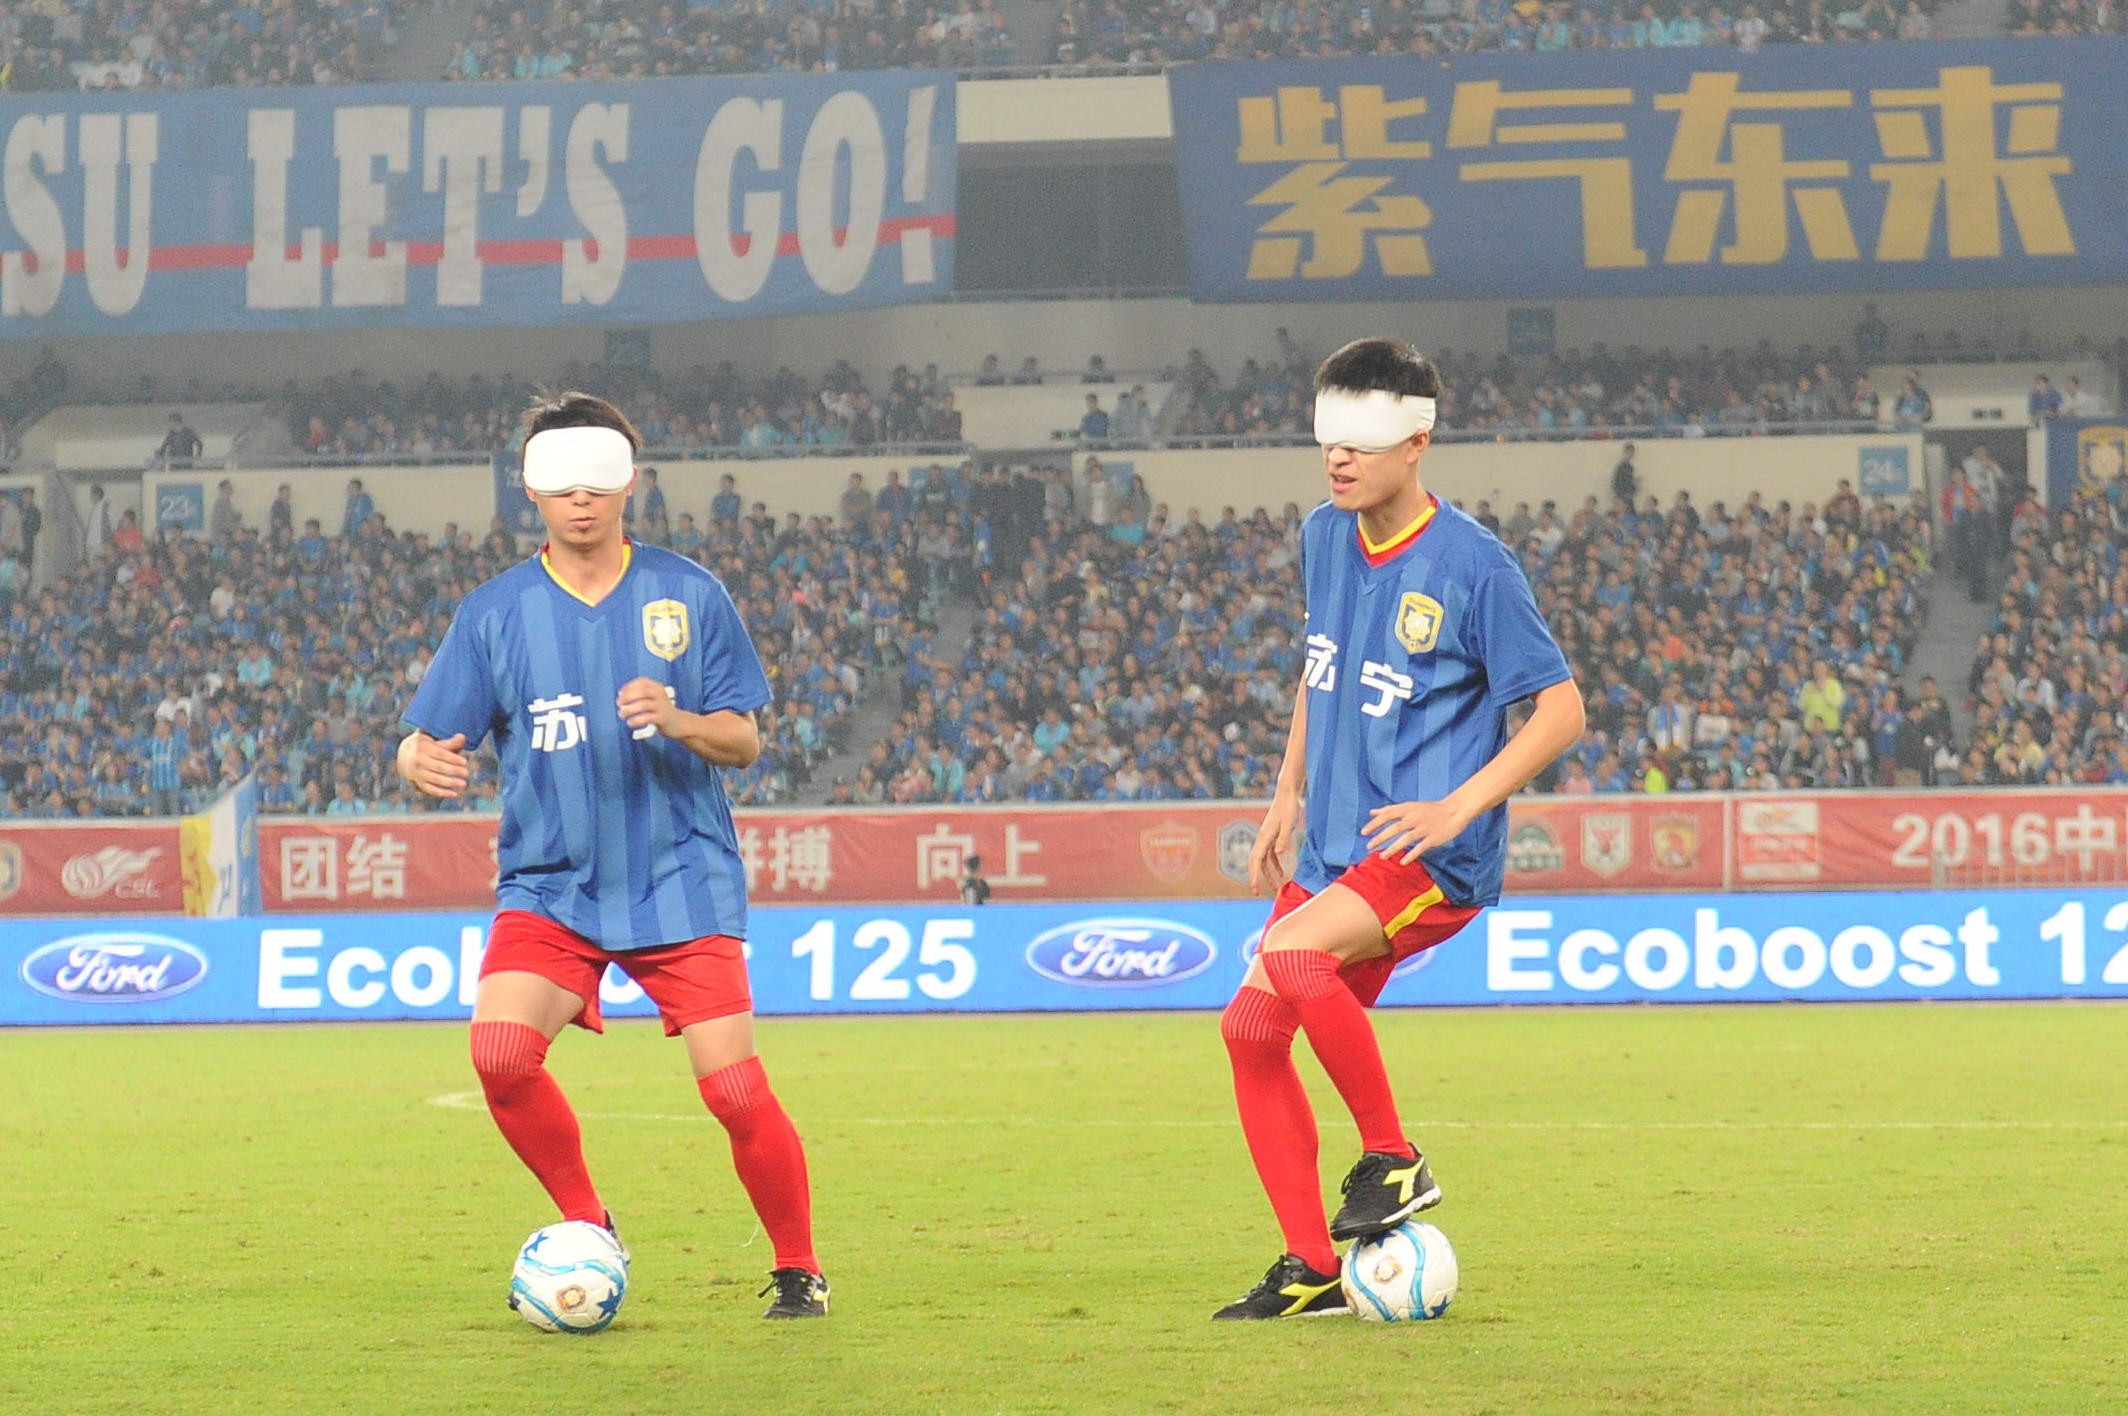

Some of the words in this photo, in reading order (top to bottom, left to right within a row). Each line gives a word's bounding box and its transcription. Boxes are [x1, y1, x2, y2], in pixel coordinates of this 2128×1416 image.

[2, 112, 158, 318] SU
[245, 103, 630, 310] LET'S
[693, 86, 938, 302] GO!
[1237, 65, 2076, 281] 紫气东来
[280, 832, 408, 901] 团结
[916, 822, 1048, 890] 向上
[1892, 803, 2128, 873] 2016中
[56, 943, 170, 993] Ford
[792, 918, 978, 1001] 125
[1064, 928, 1180, 979] Ford
[1486, 905, 2000, 991] Ecoboost
